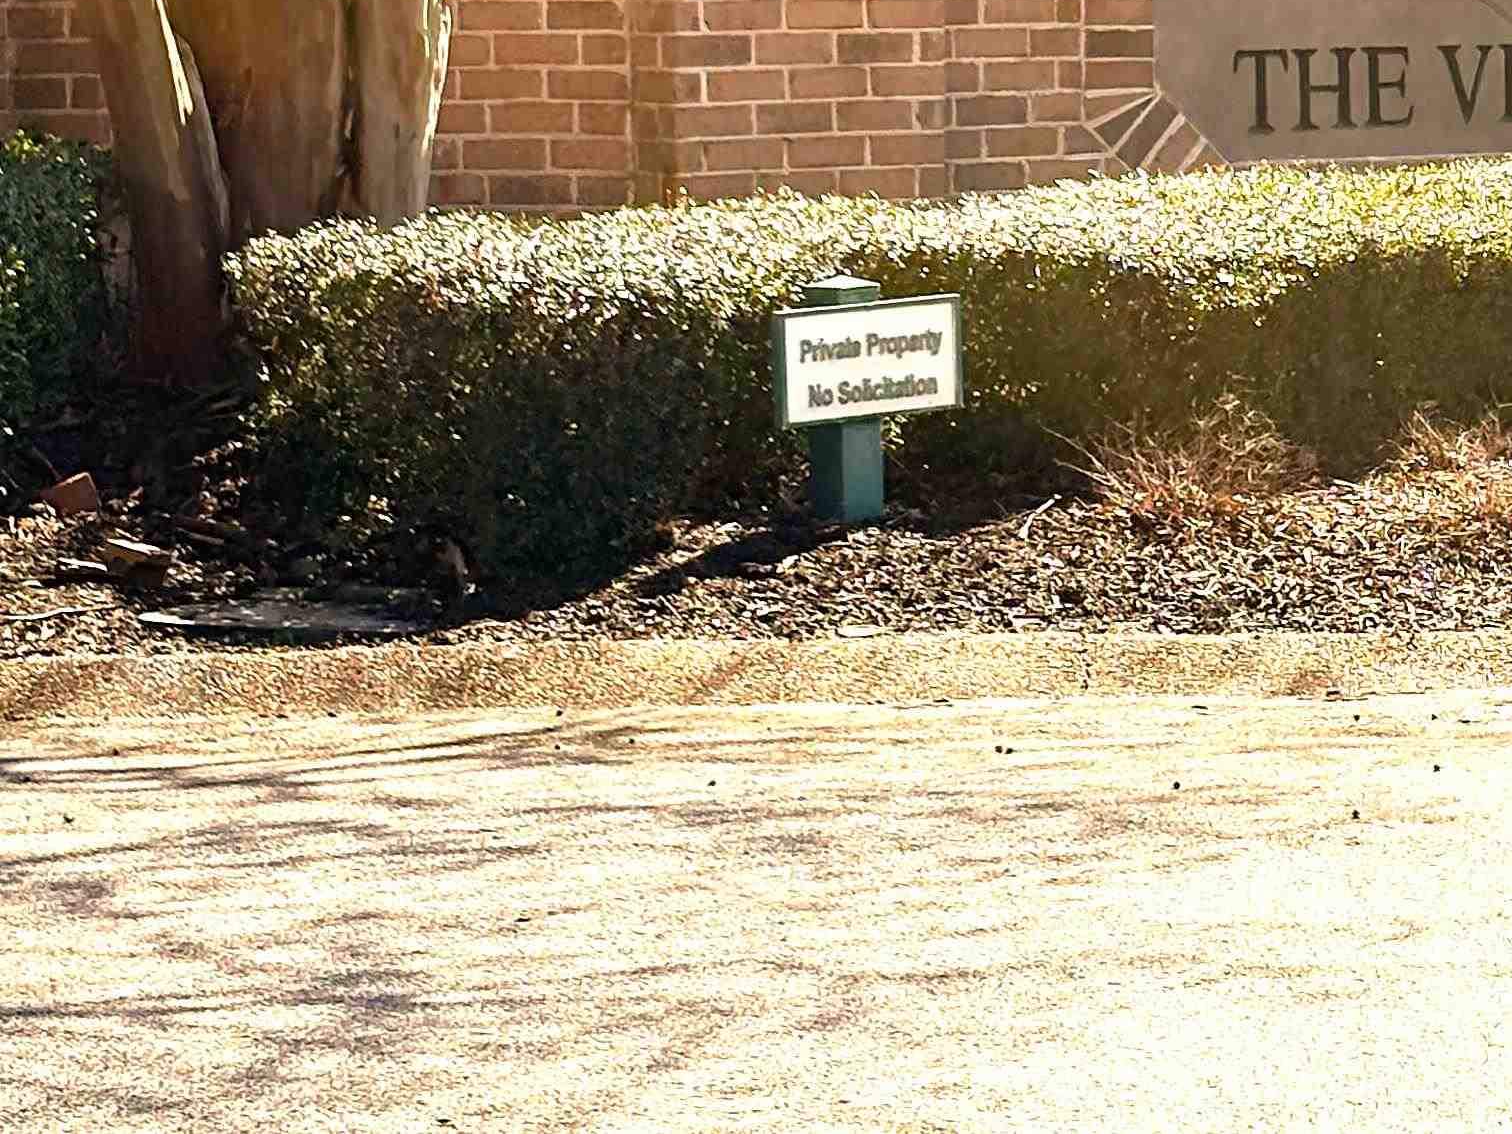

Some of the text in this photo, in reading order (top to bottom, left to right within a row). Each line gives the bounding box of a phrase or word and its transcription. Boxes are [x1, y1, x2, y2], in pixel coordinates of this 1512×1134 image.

[1233, 45, 1414, 134] THE
[799, 328, 943, 363] Private Property
[807, 373, 939, 408] No Solicitation
